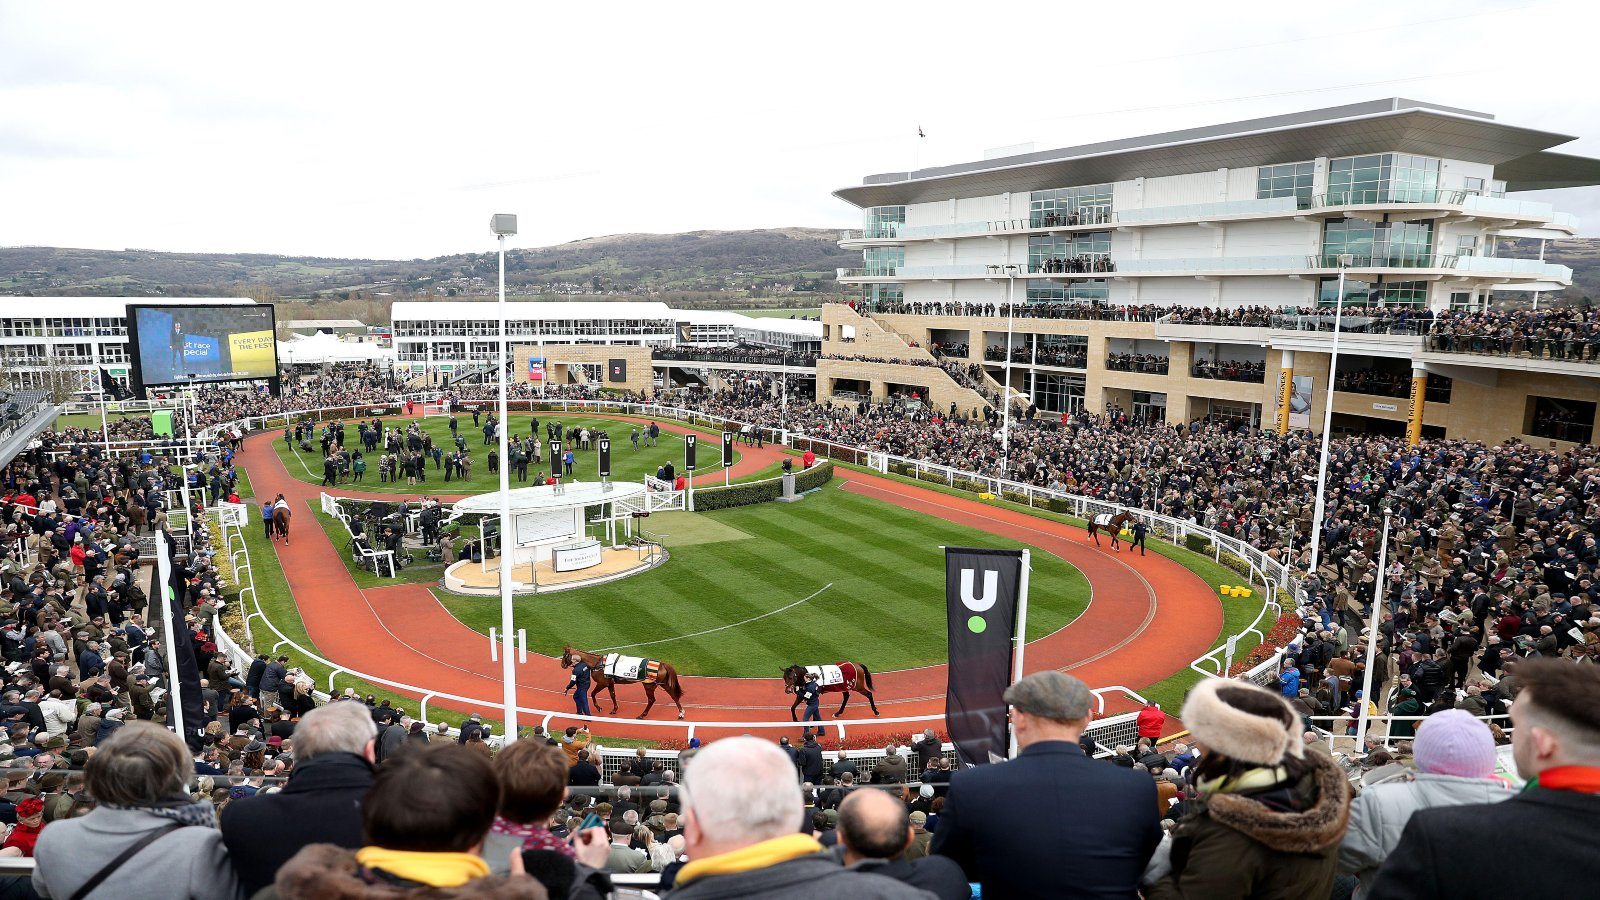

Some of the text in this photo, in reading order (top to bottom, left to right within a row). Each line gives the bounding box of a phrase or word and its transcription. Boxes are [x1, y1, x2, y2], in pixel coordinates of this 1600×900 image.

[183, 348, 208, 357] pecial
[1278, 371, 1287, 403] MAGNERS
[1408, 380, 1418, 416] MAGNERS
[960, 568, 998, 612] U
[630, 665, 637, 673] 8
[829, 670, 841, 679] 15
